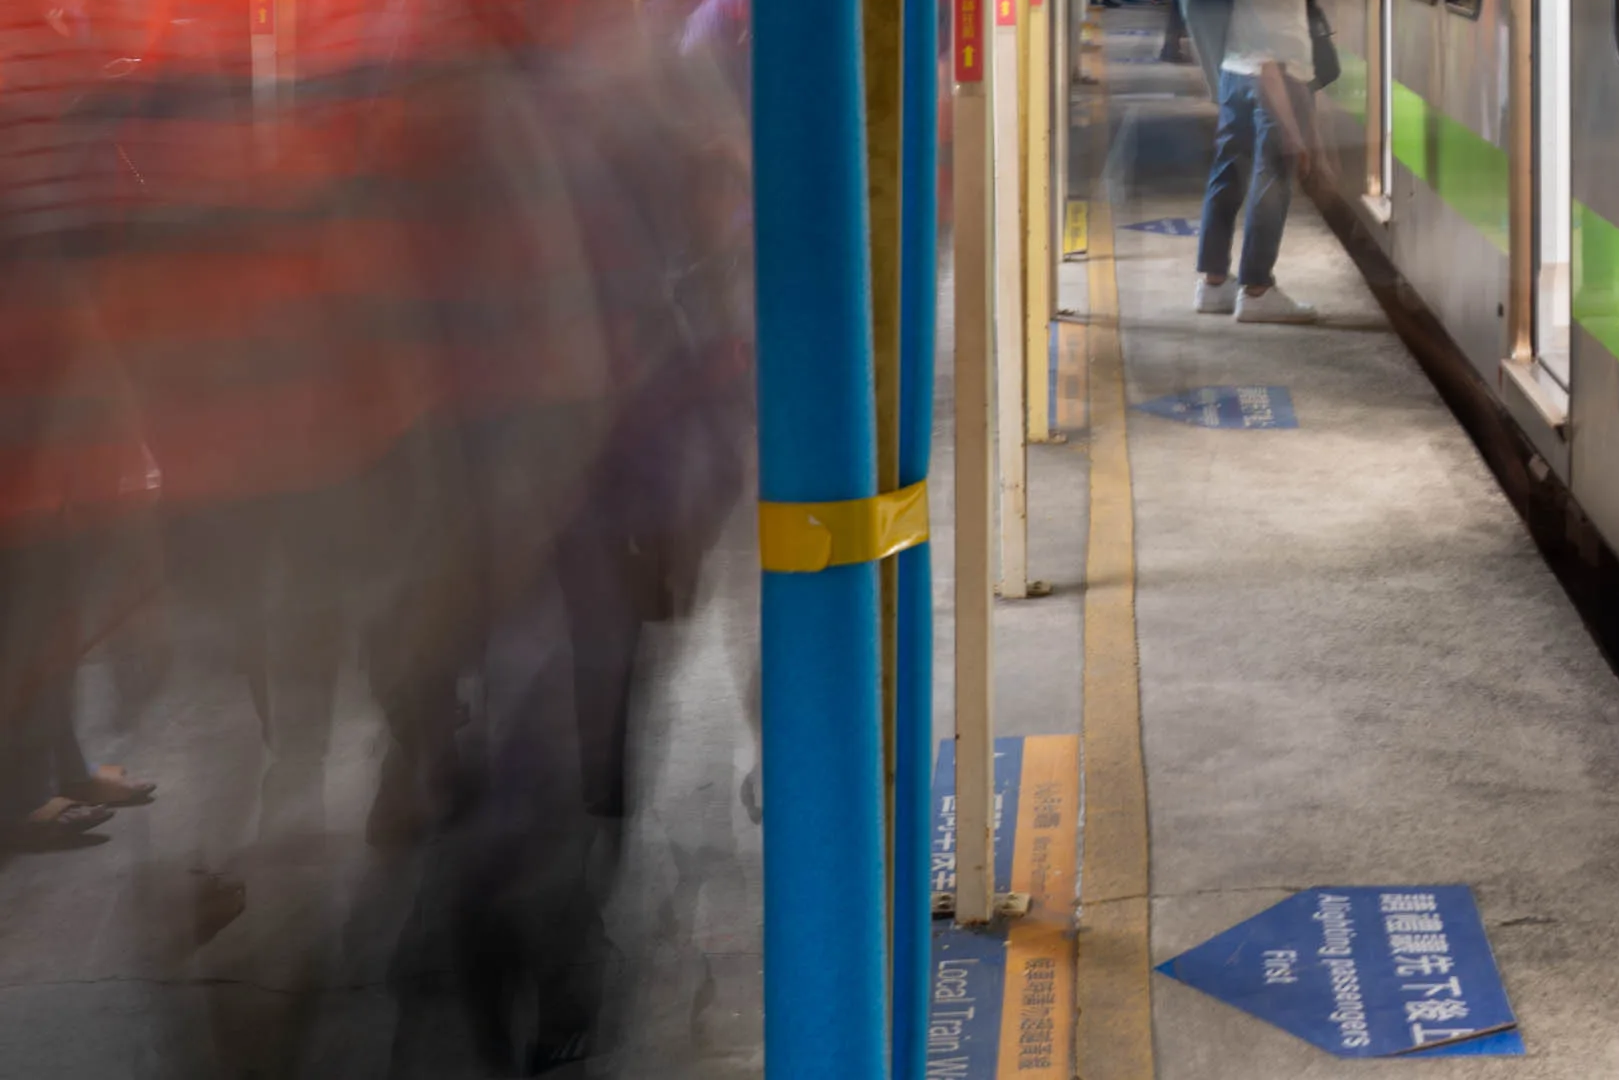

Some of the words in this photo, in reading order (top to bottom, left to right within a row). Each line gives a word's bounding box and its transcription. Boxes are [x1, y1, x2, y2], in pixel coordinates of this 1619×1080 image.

[1312, 893, 1357, 956] Alighting
[934, 958, 980, 1004] Local
[1262, 949, 1298, 985] First
[1380, 893, 1475, 1047] 請禮讓先下後上
[926, 1006, 975, 1054] Train
[1319, 958, 1371, 1048] passengers
